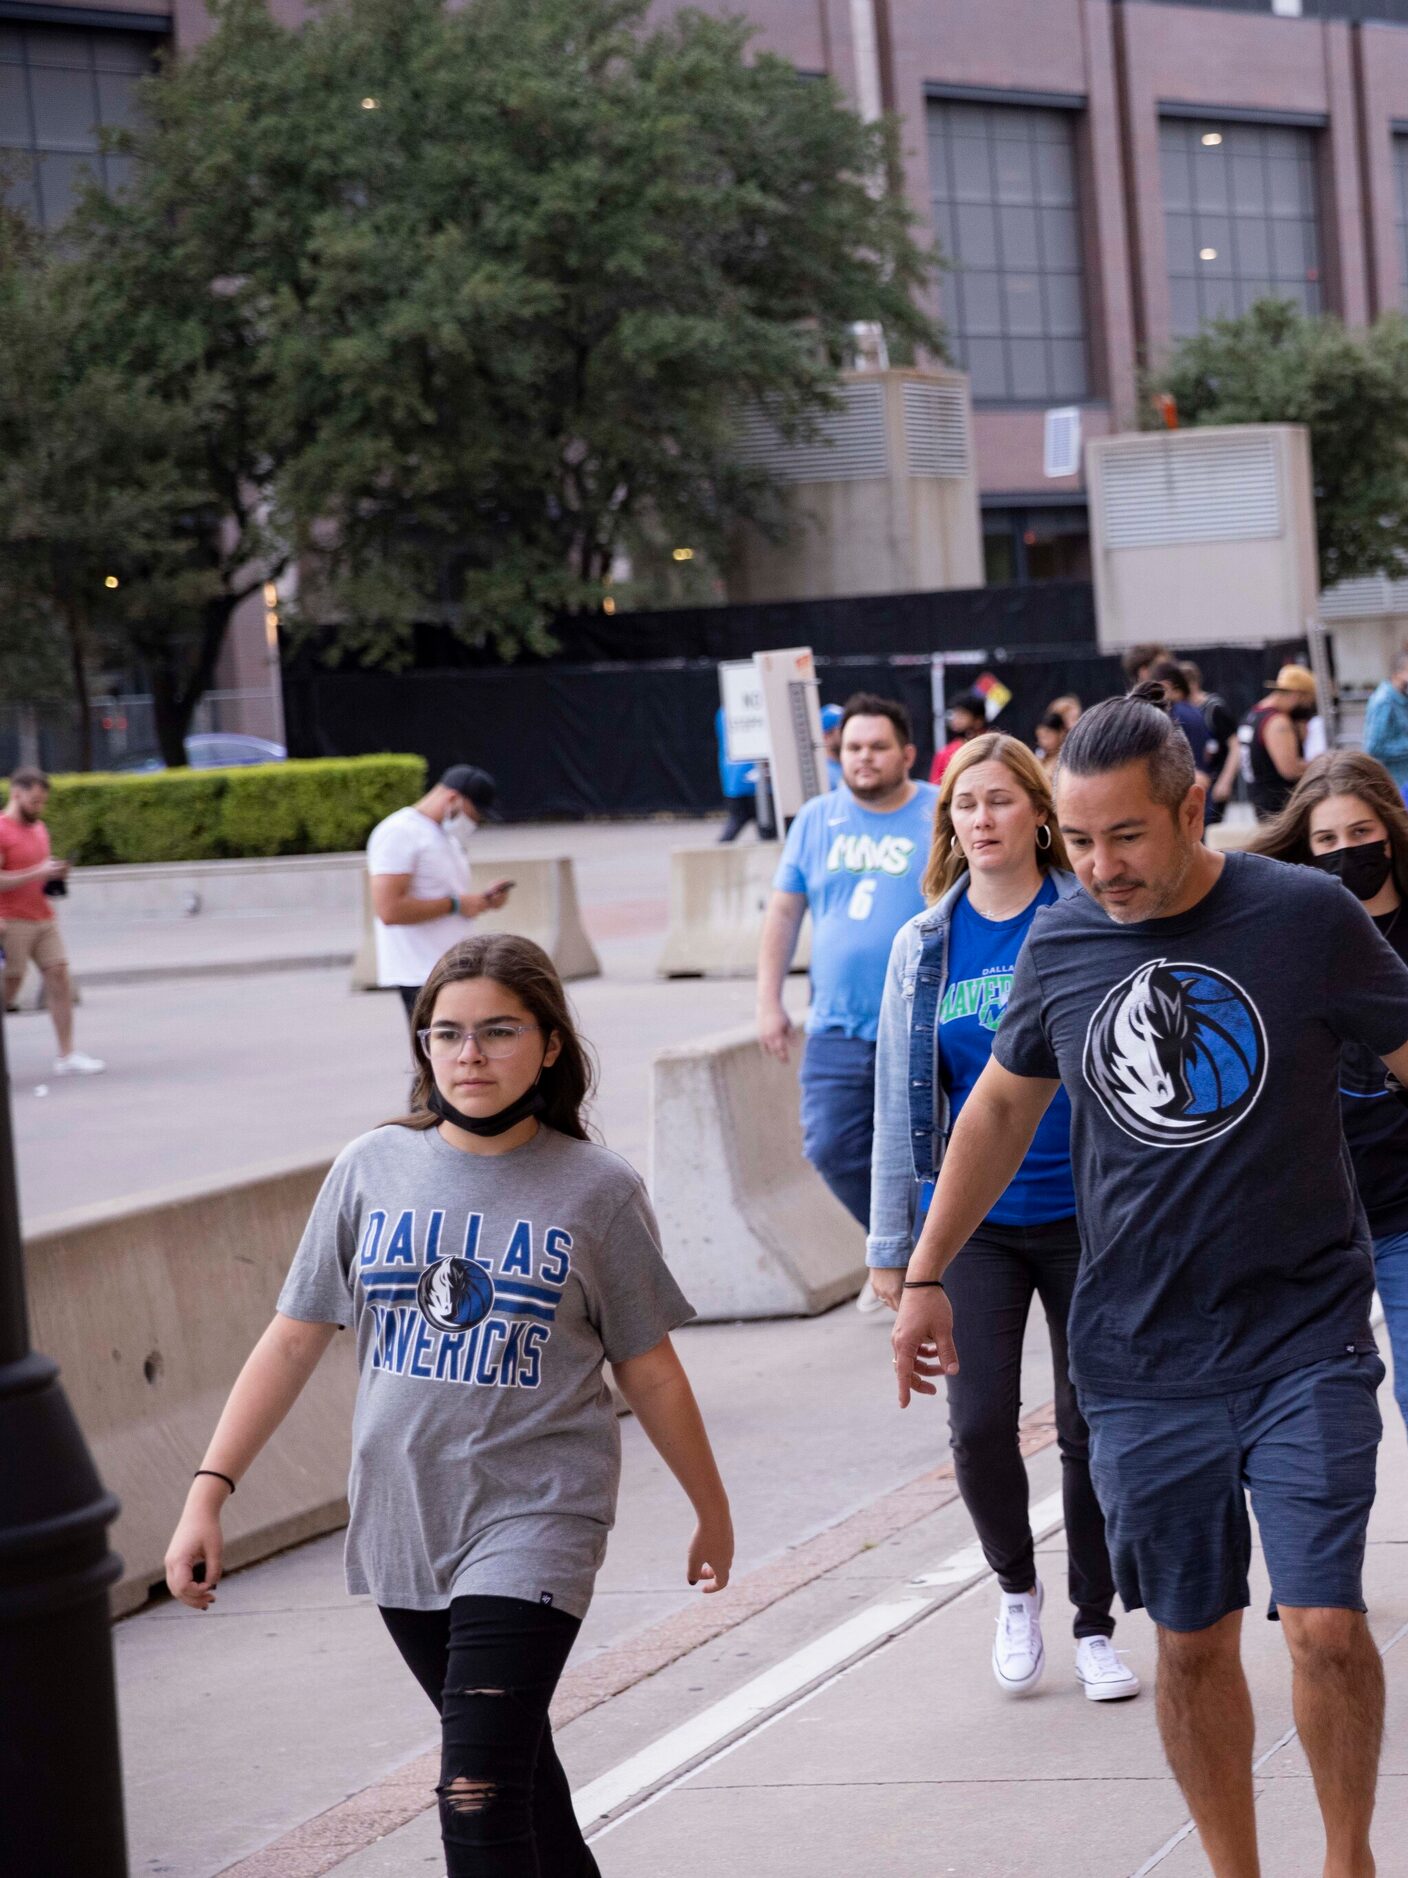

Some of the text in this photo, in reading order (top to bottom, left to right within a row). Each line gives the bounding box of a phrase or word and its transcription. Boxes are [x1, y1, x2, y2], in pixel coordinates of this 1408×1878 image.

[827, 833, 915, 875] MAVS
[848, 878, 877, 920] 6
[982, 964, 1014, 975] DALLA
[360, 1208, 574, 1287] DALLAS
[367, 1303, 552, 1390] MAVERICKS
